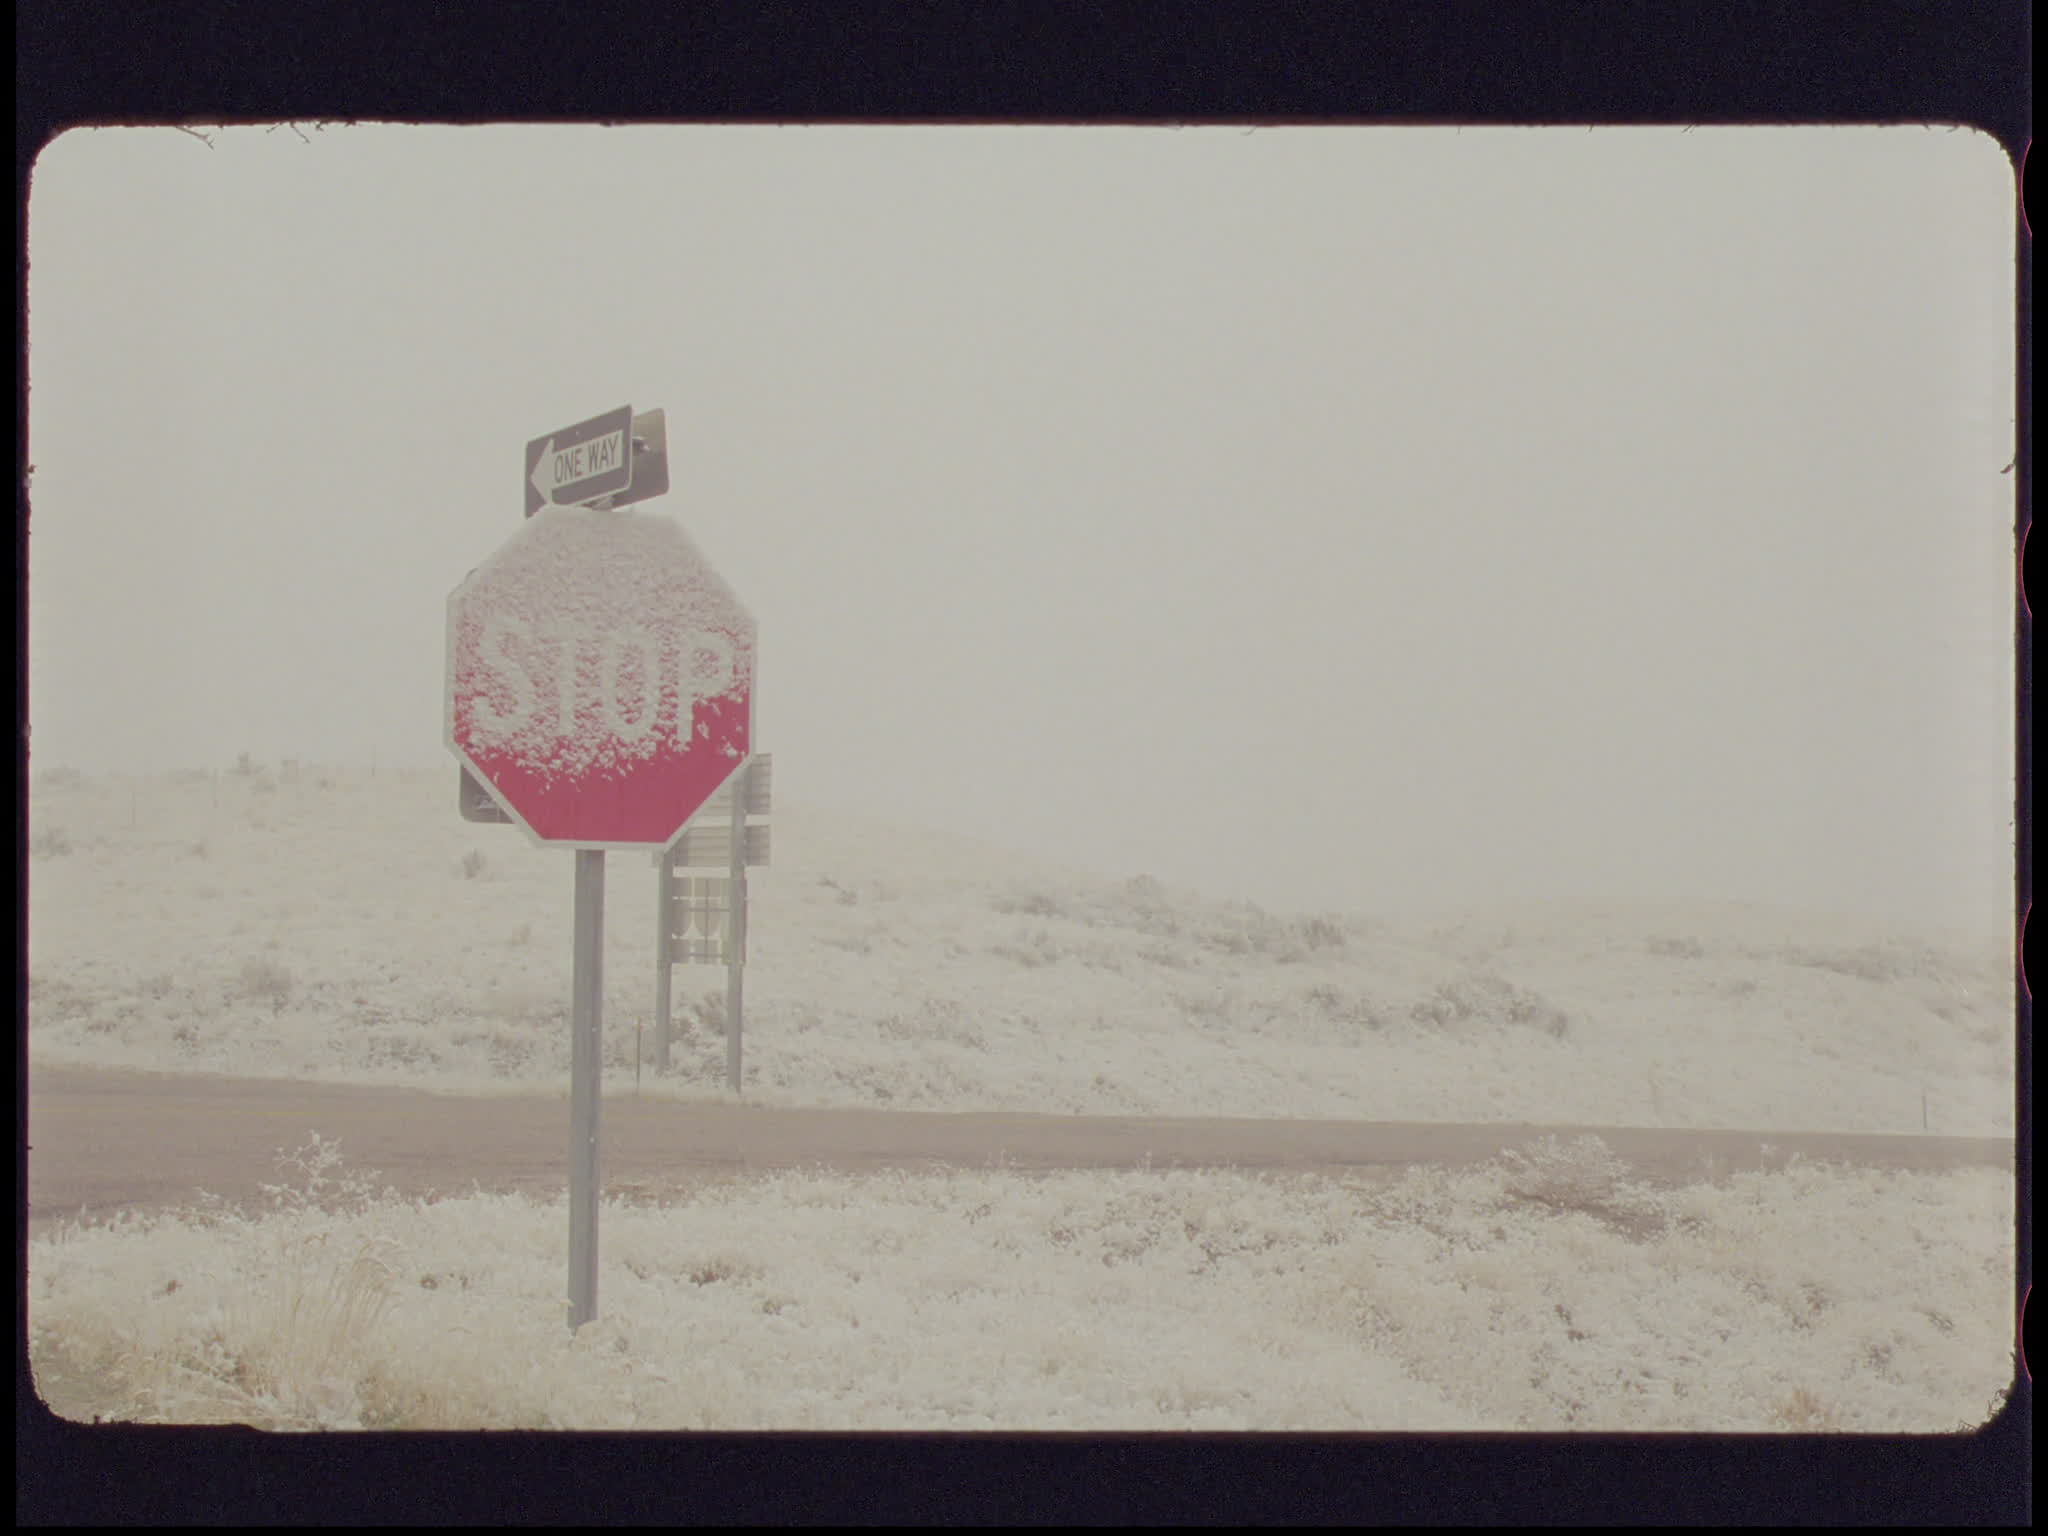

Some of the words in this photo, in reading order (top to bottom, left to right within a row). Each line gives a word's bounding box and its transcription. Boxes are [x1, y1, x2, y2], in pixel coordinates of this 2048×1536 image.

[554, 447, 583, 484] ONE
[587, 434, 619, 473] WAY
[469, 615, 733, 744] STOP
